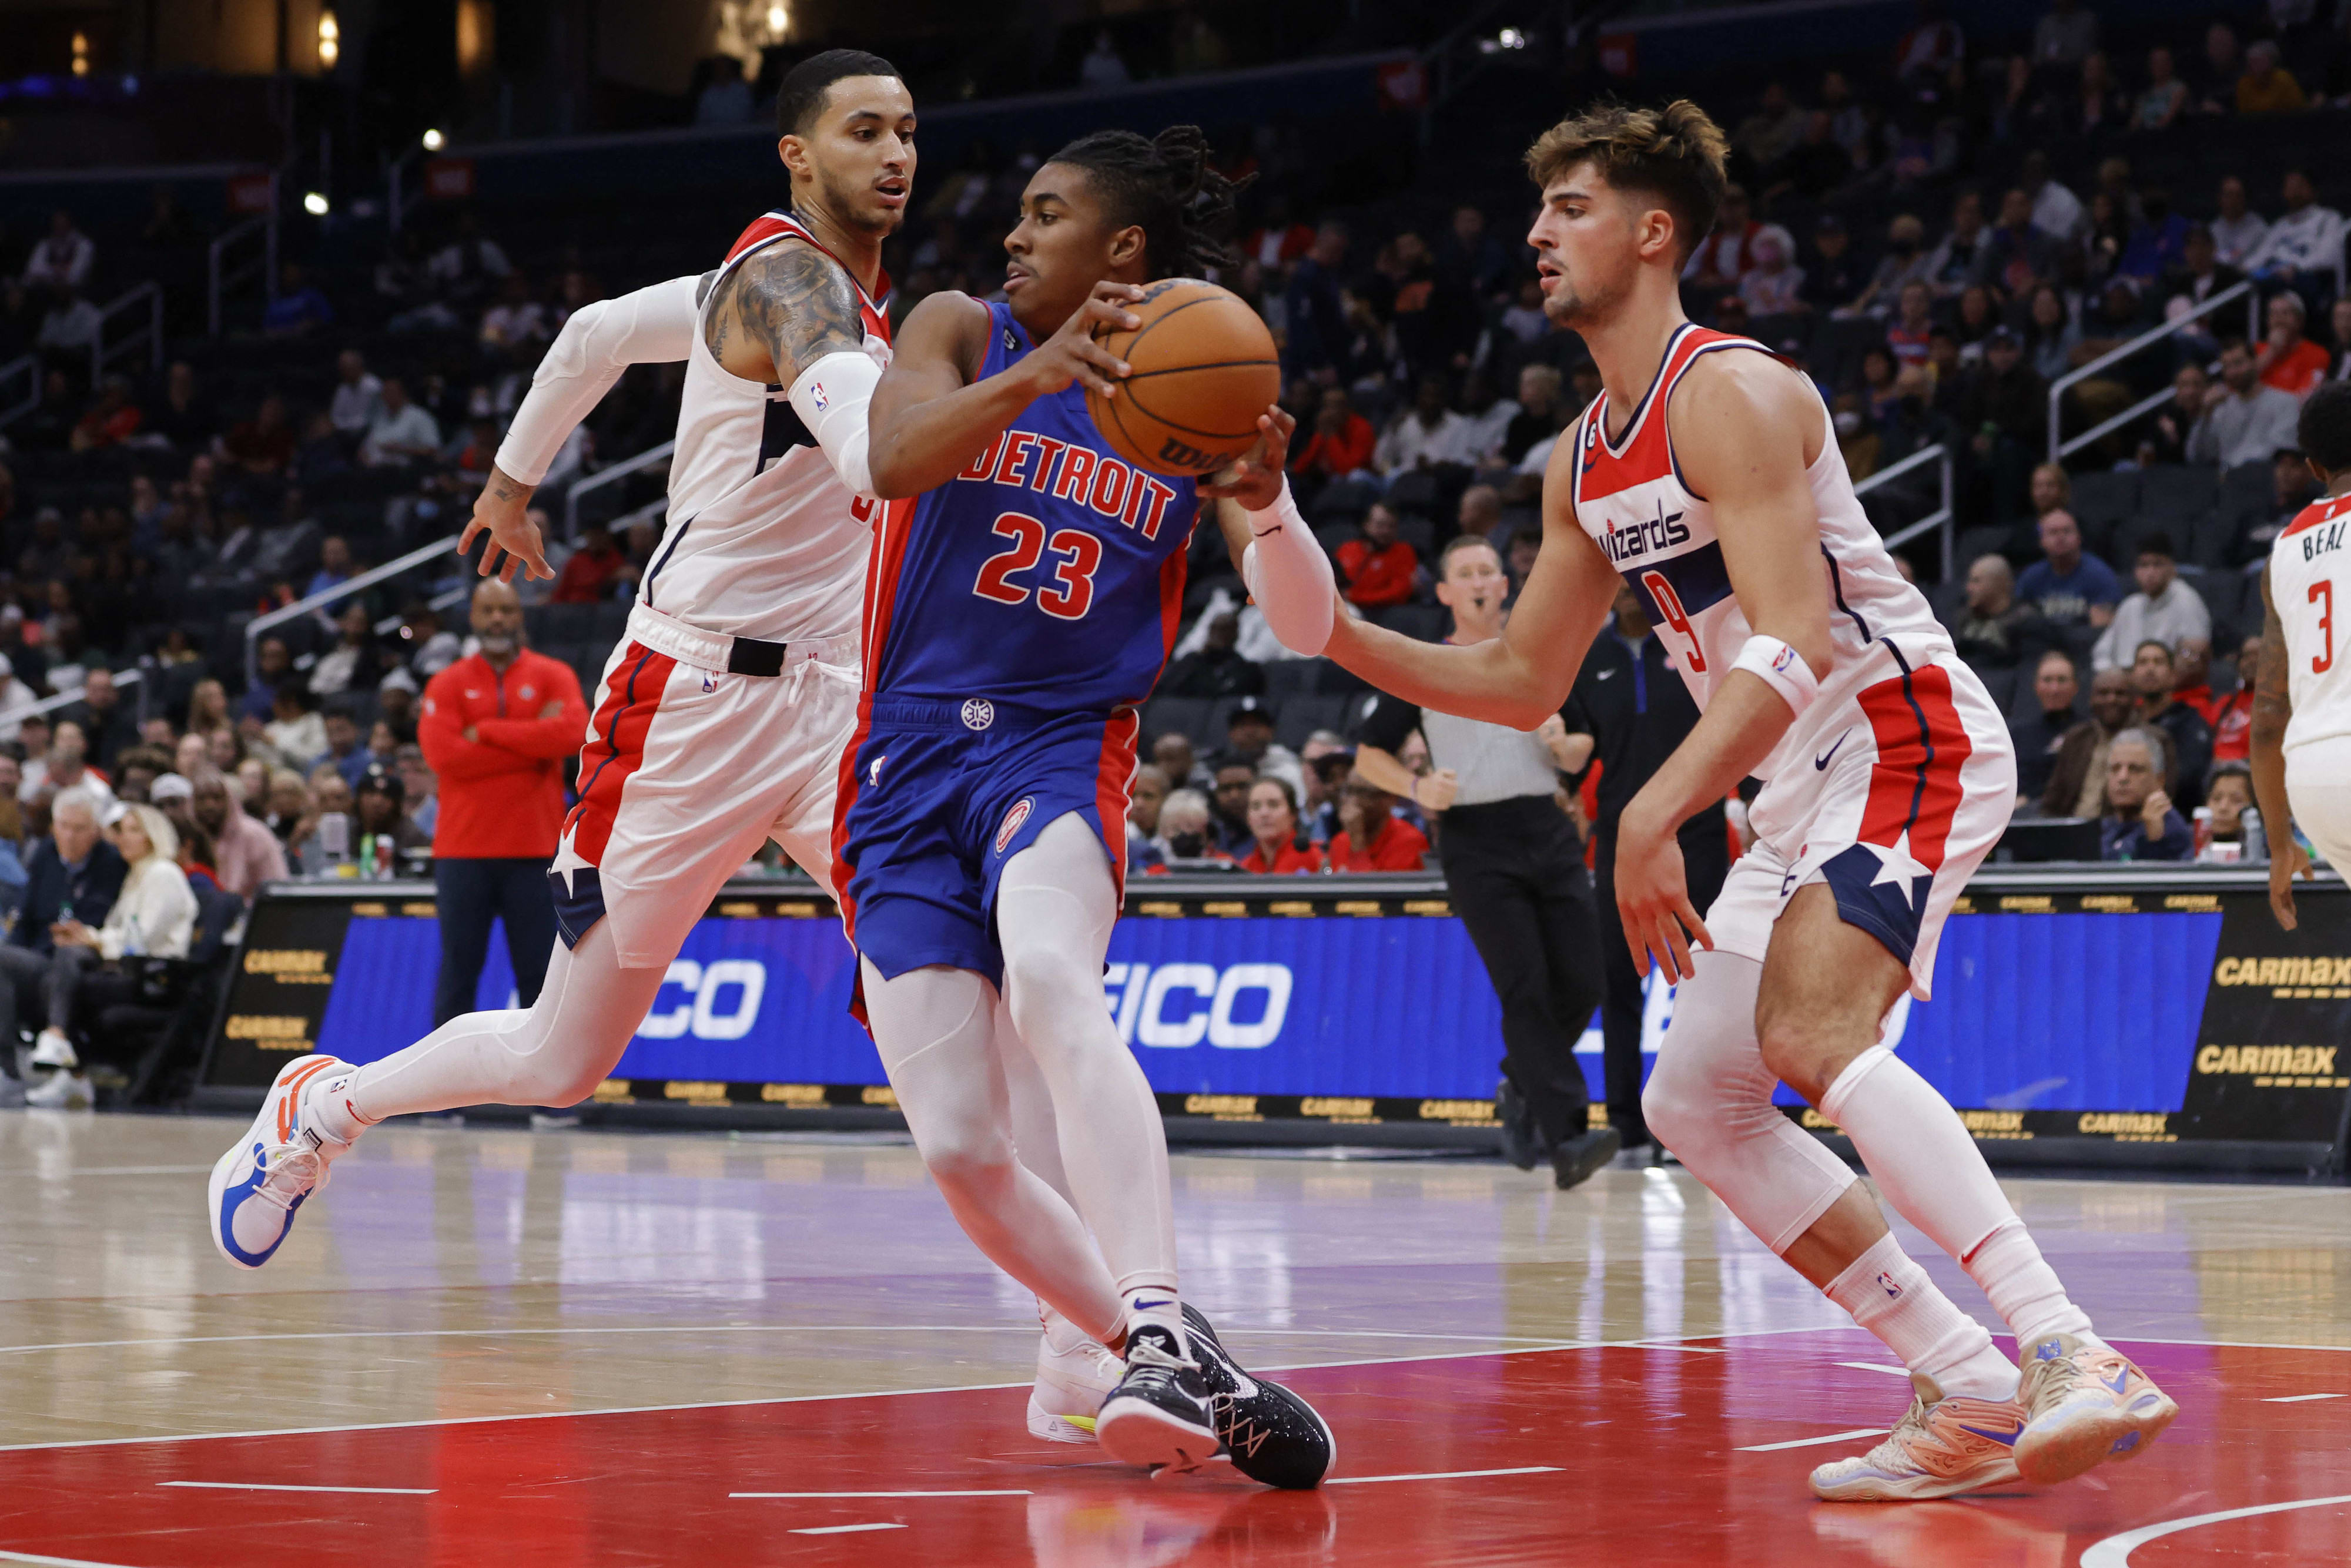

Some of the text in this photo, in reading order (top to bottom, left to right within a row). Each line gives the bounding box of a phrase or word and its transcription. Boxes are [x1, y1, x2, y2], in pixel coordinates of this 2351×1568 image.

[957, 430, 1177, 541] DETROIT
[973, 511, 1103, 620] 23
[2303, 521, 2346, 562] BEAL
[1641, 569, 1708, 676] 9
[2308, 579, 2332, 674] 3
[1103, 963, 1293, 1049] ICO
